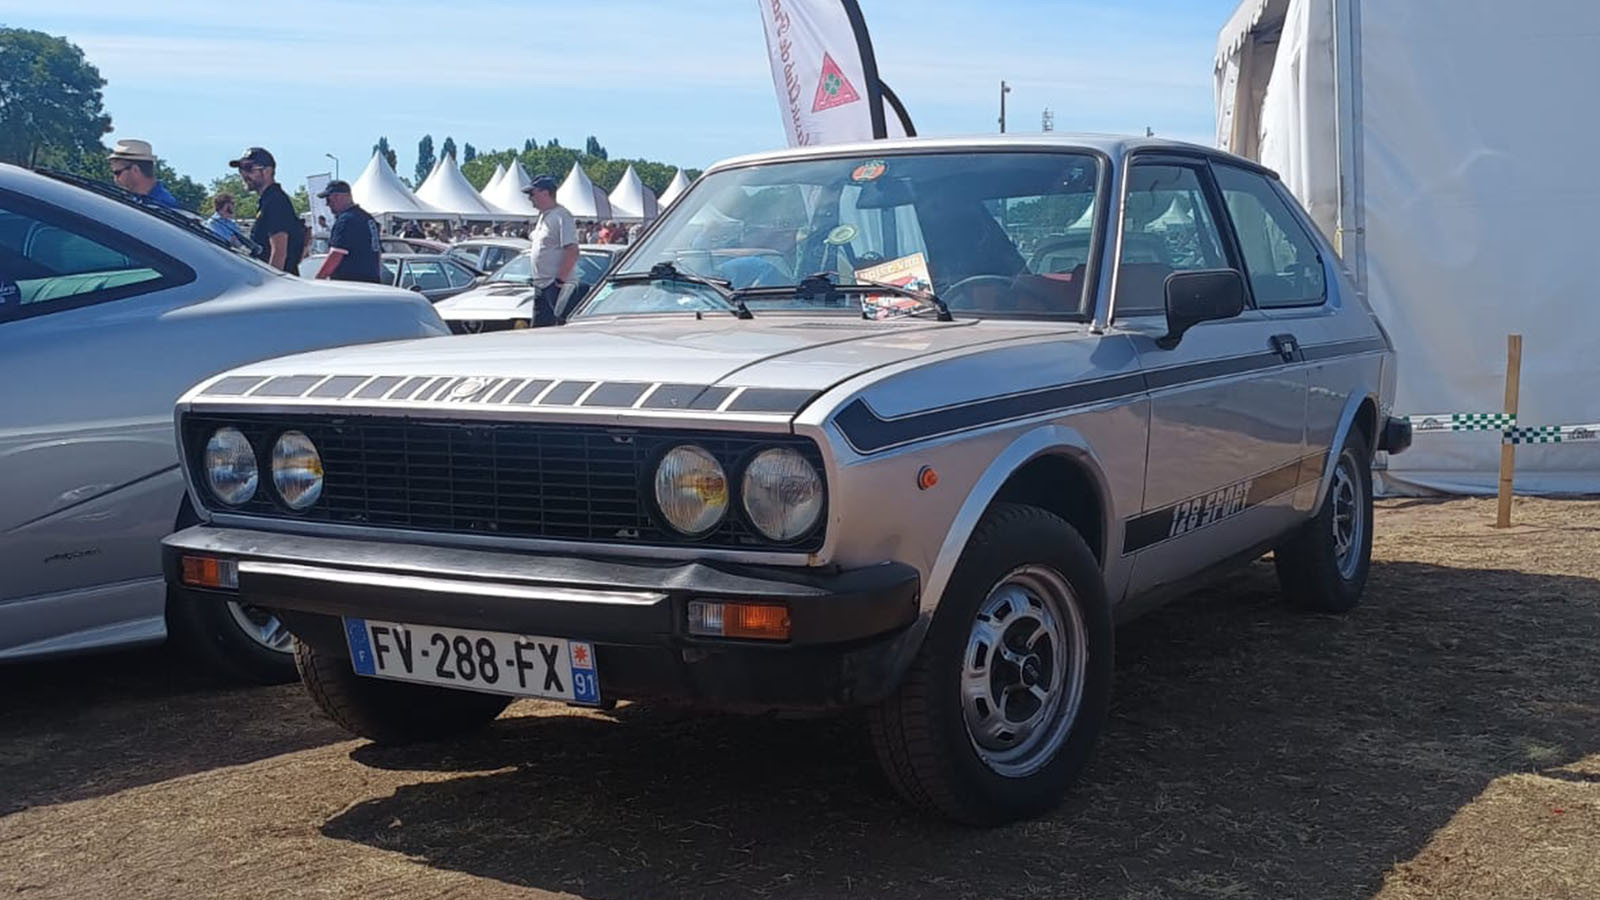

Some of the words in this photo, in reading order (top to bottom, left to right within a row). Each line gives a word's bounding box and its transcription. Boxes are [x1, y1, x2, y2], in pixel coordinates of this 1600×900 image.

[1169, 498, 1202, 537] 128
[1201, 481, 1253, 527] SPORT
[358, 650, 366, 663] F
[371, 626, 565, 693] FV-288-FX
[575, 673, 595, 696] 91
